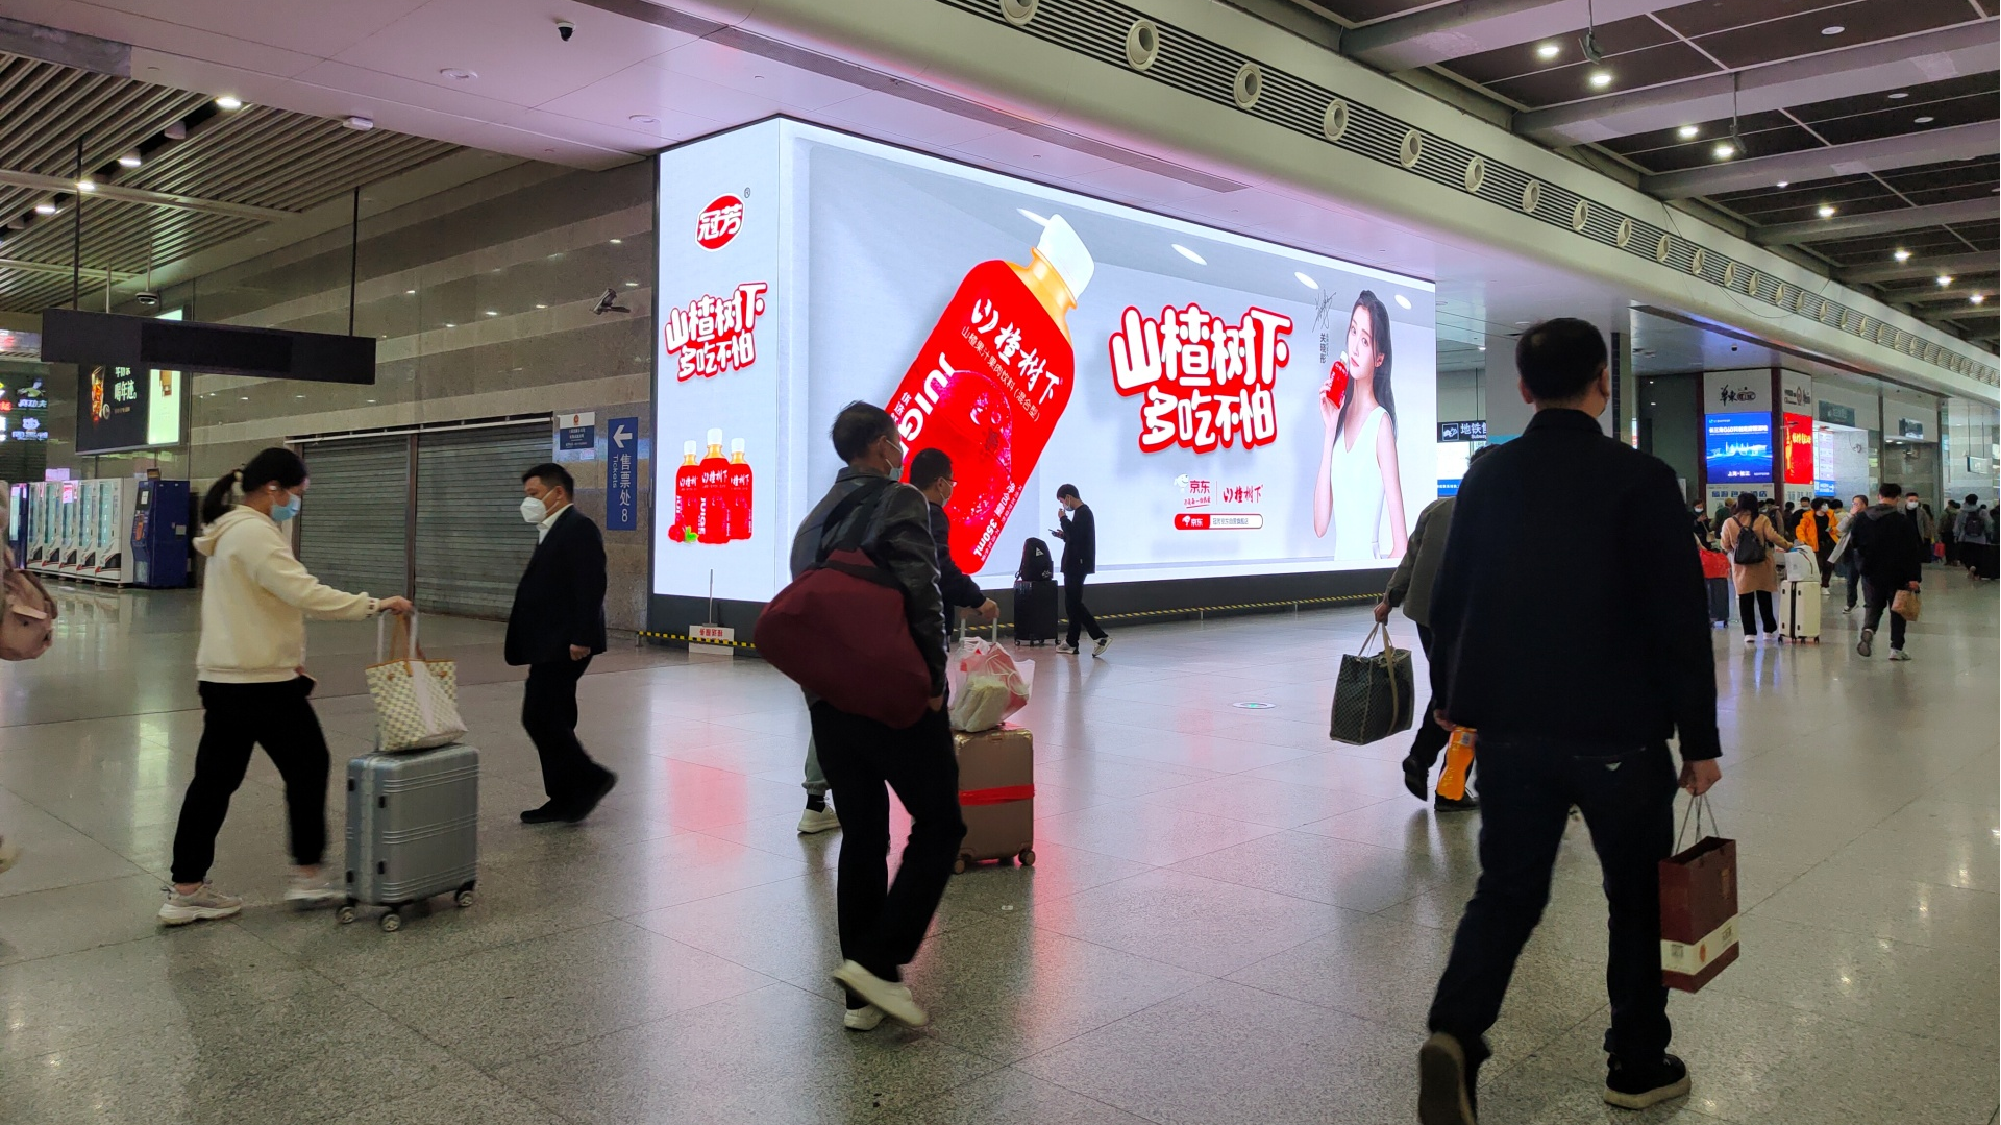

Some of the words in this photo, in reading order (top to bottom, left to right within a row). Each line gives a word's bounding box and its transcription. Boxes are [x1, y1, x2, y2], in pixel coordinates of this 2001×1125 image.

[697, 203, 743, 240] 冠芳
[666, 283, 767, 353] 山楂树下
[678, 330, 755, 380] 多吃不怕
[1110, 303, 1292, 394] 山楂树下
[1140, 383, 1276, 451] 多吃不怕
[620, 453, 631, 506] 售票处
[1189, 480, 1210, 494] 京东
[621, 508, 628, 522] 8
